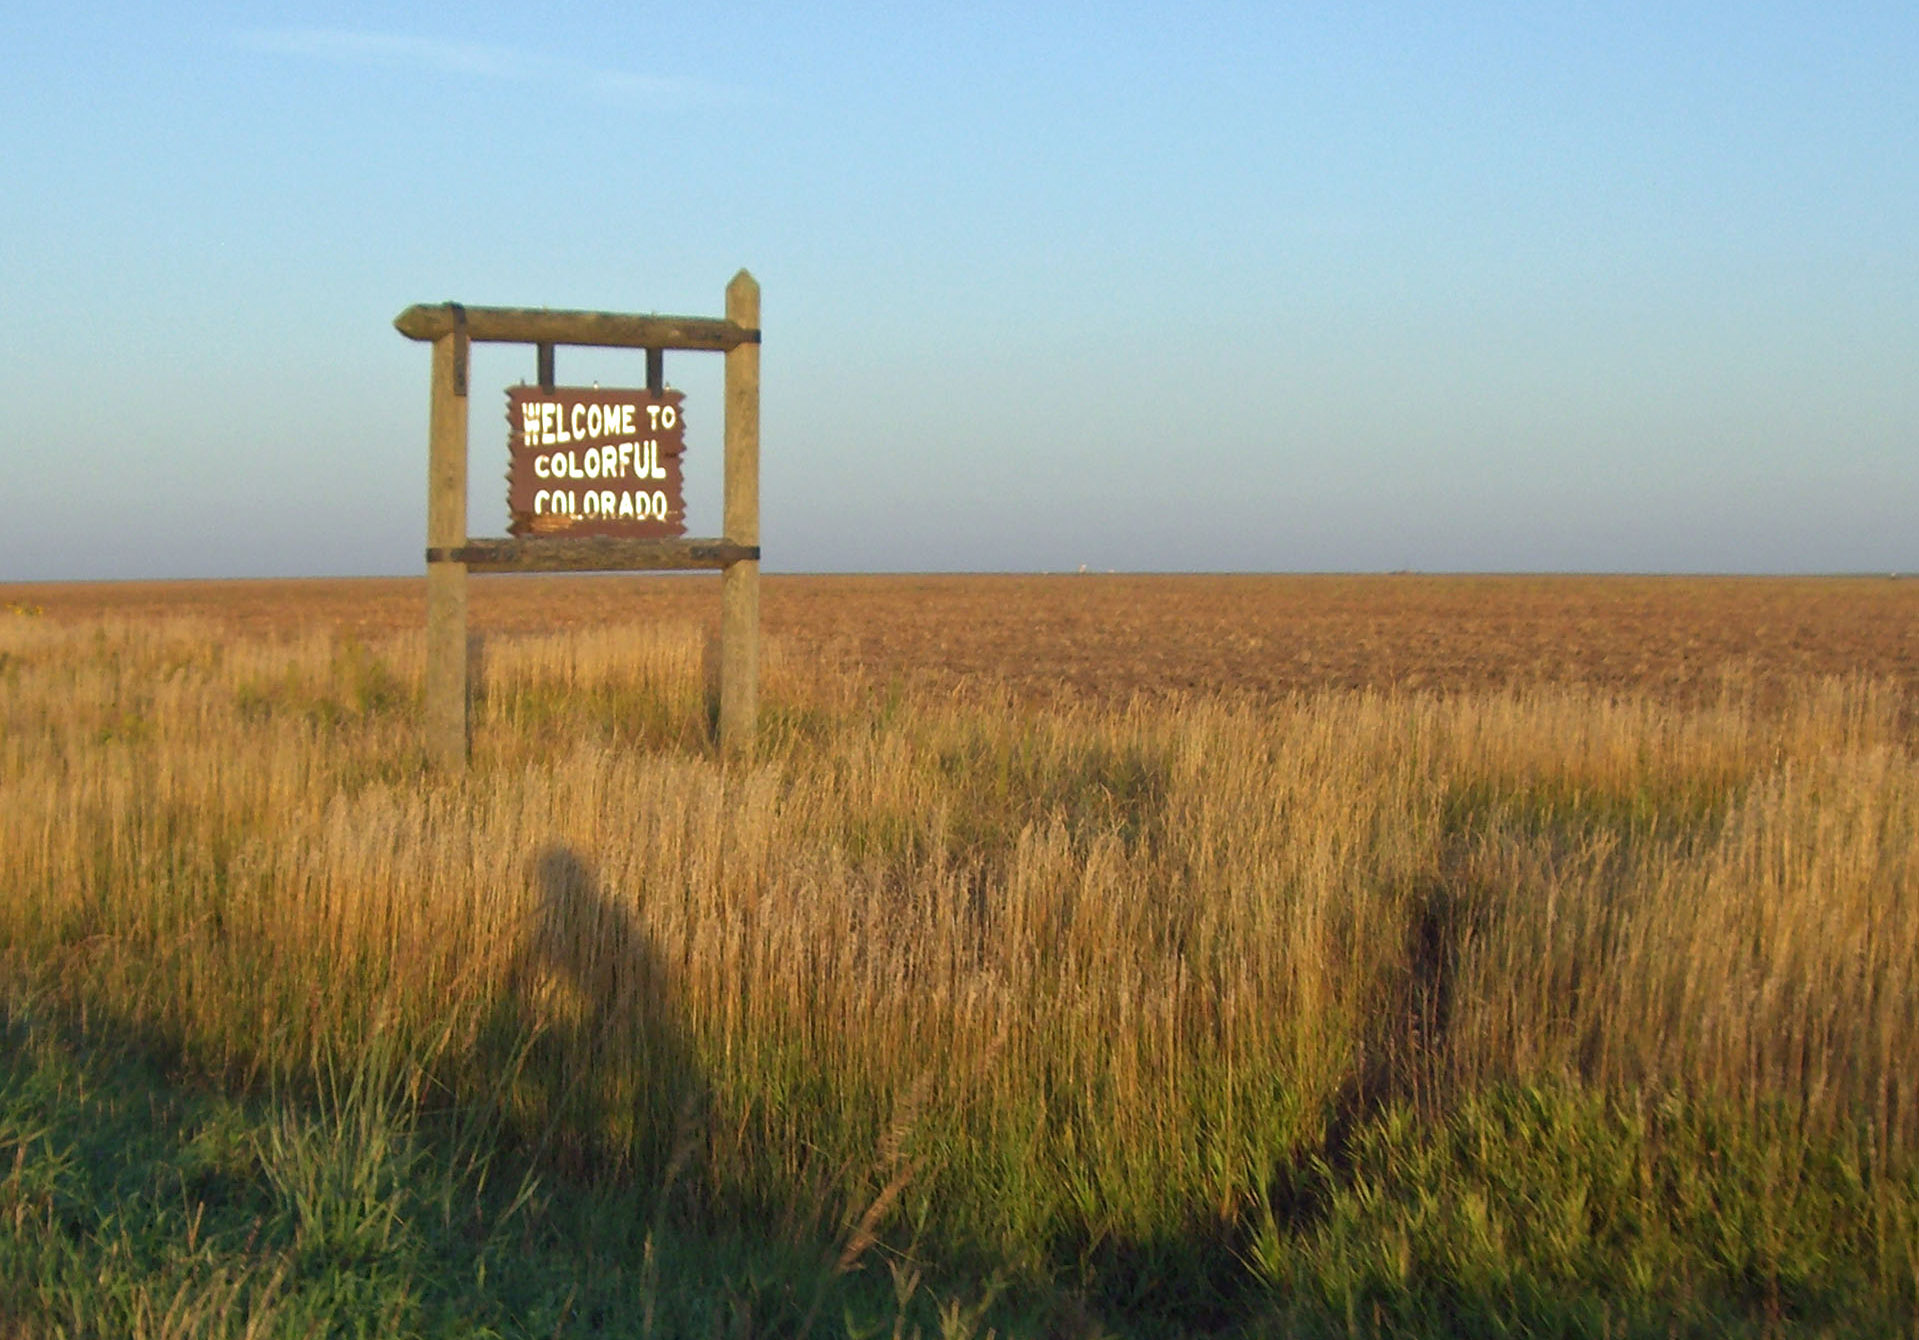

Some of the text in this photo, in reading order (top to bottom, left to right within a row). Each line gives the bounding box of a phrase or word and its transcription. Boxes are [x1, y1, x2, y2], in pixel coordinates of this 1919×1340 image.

[521, 402, 676, 447] WELCOME TO
[534, 440, 666, 480] COLORFUL
[534, 490, 668, 521] COLORADO
